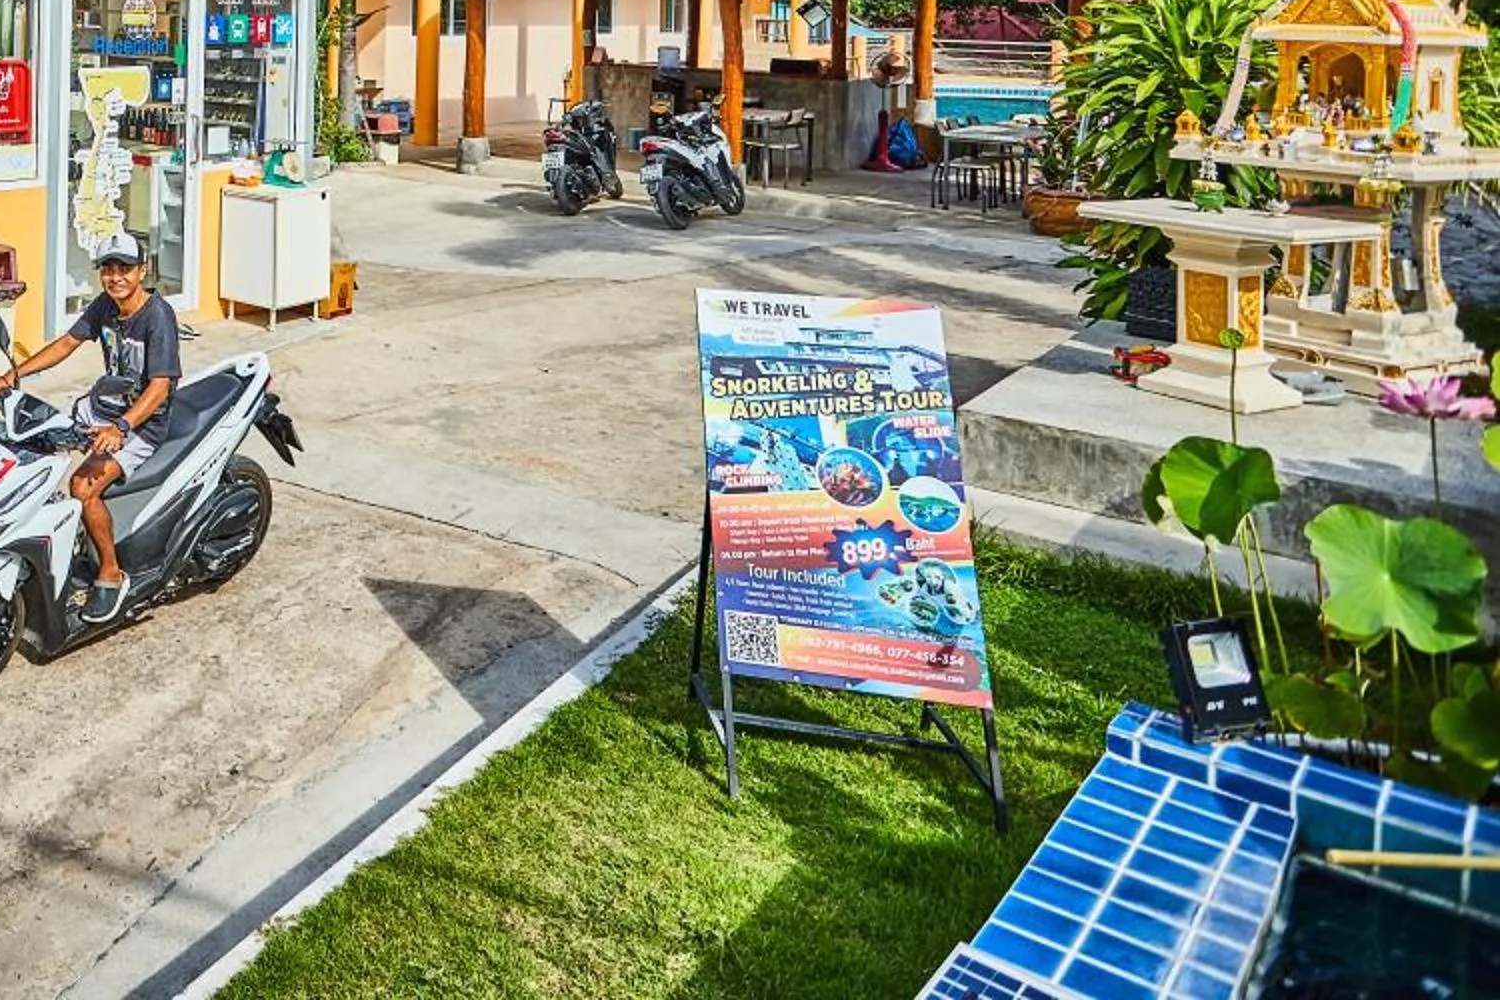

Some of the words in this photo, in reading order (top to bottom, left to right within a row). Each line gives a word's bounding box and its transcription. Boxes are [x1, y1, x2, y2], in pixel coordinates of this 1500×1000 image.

[94, 34, 168, 56] Reception
[724, 300, 748, 315] WE
[752, 301, 811, 318] TRAVEL
[712, 371, 847, 396] SNORKELING
[854, 369, 873, 394] &
[730, 397, 874, 420] ADVENTURES
[881, 391, 944, 412] TOUR
[748, 563, 778, 581] Tour
[783, 567, 846, 587] Included
